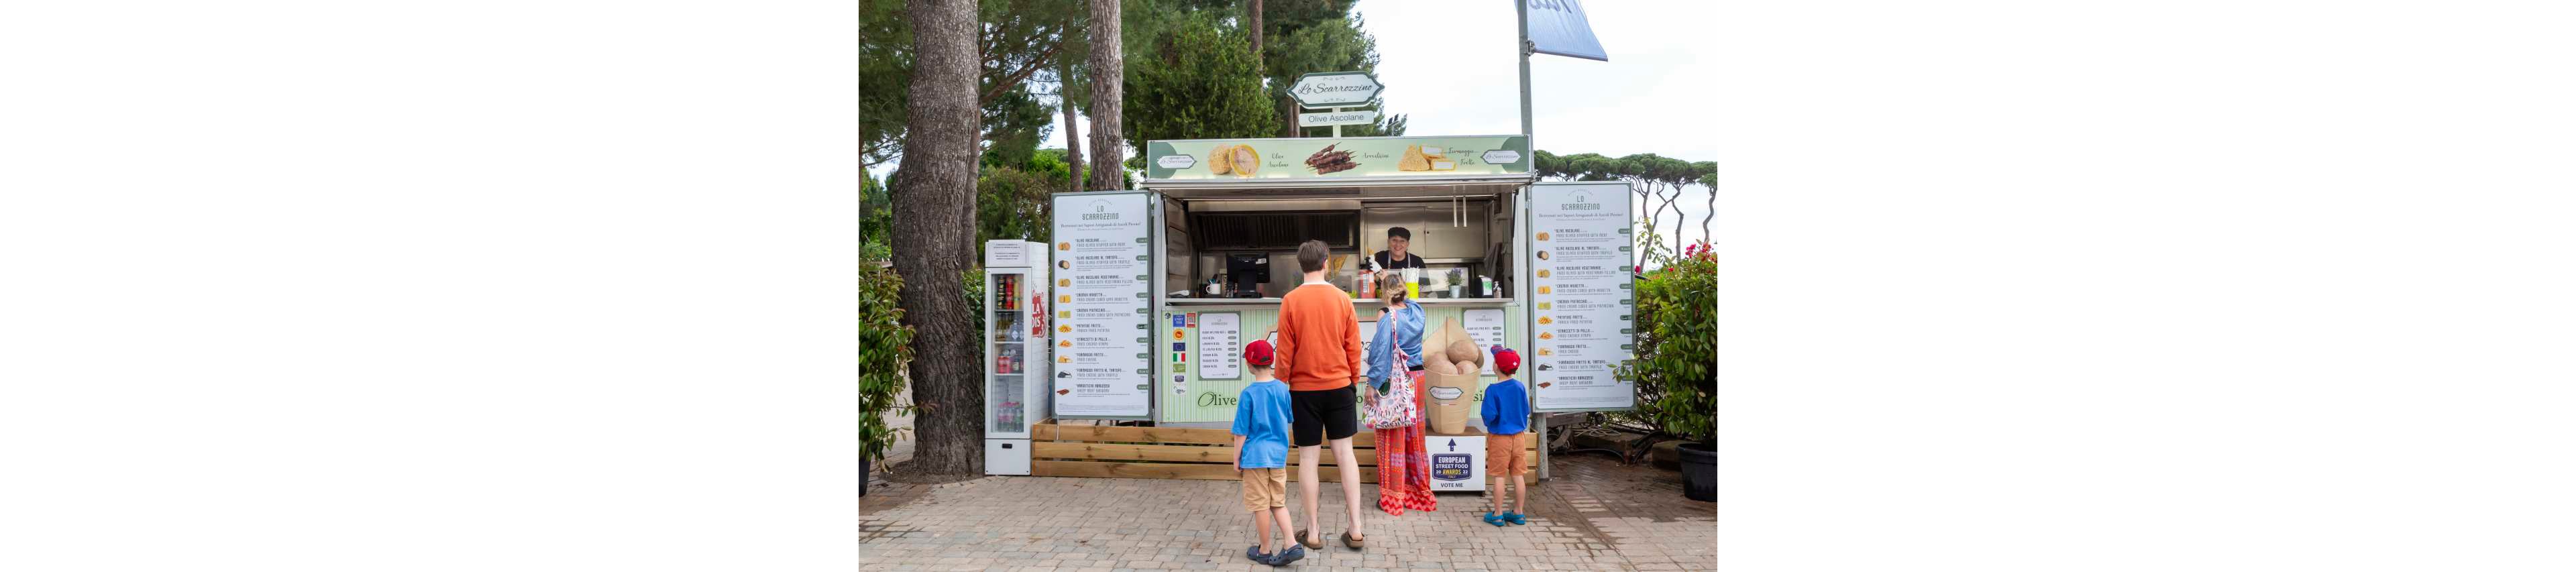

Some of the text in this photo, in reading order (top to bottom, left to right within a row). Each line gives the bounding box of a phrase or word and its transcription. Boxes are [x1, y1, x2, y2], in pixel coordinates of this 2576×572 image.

[1298, 83, 1372, 95] Lo Scarrozzino
[1082, 213, 1119, 221] SCARROZZINO
[1197, 392, 1236, 407] Olive
